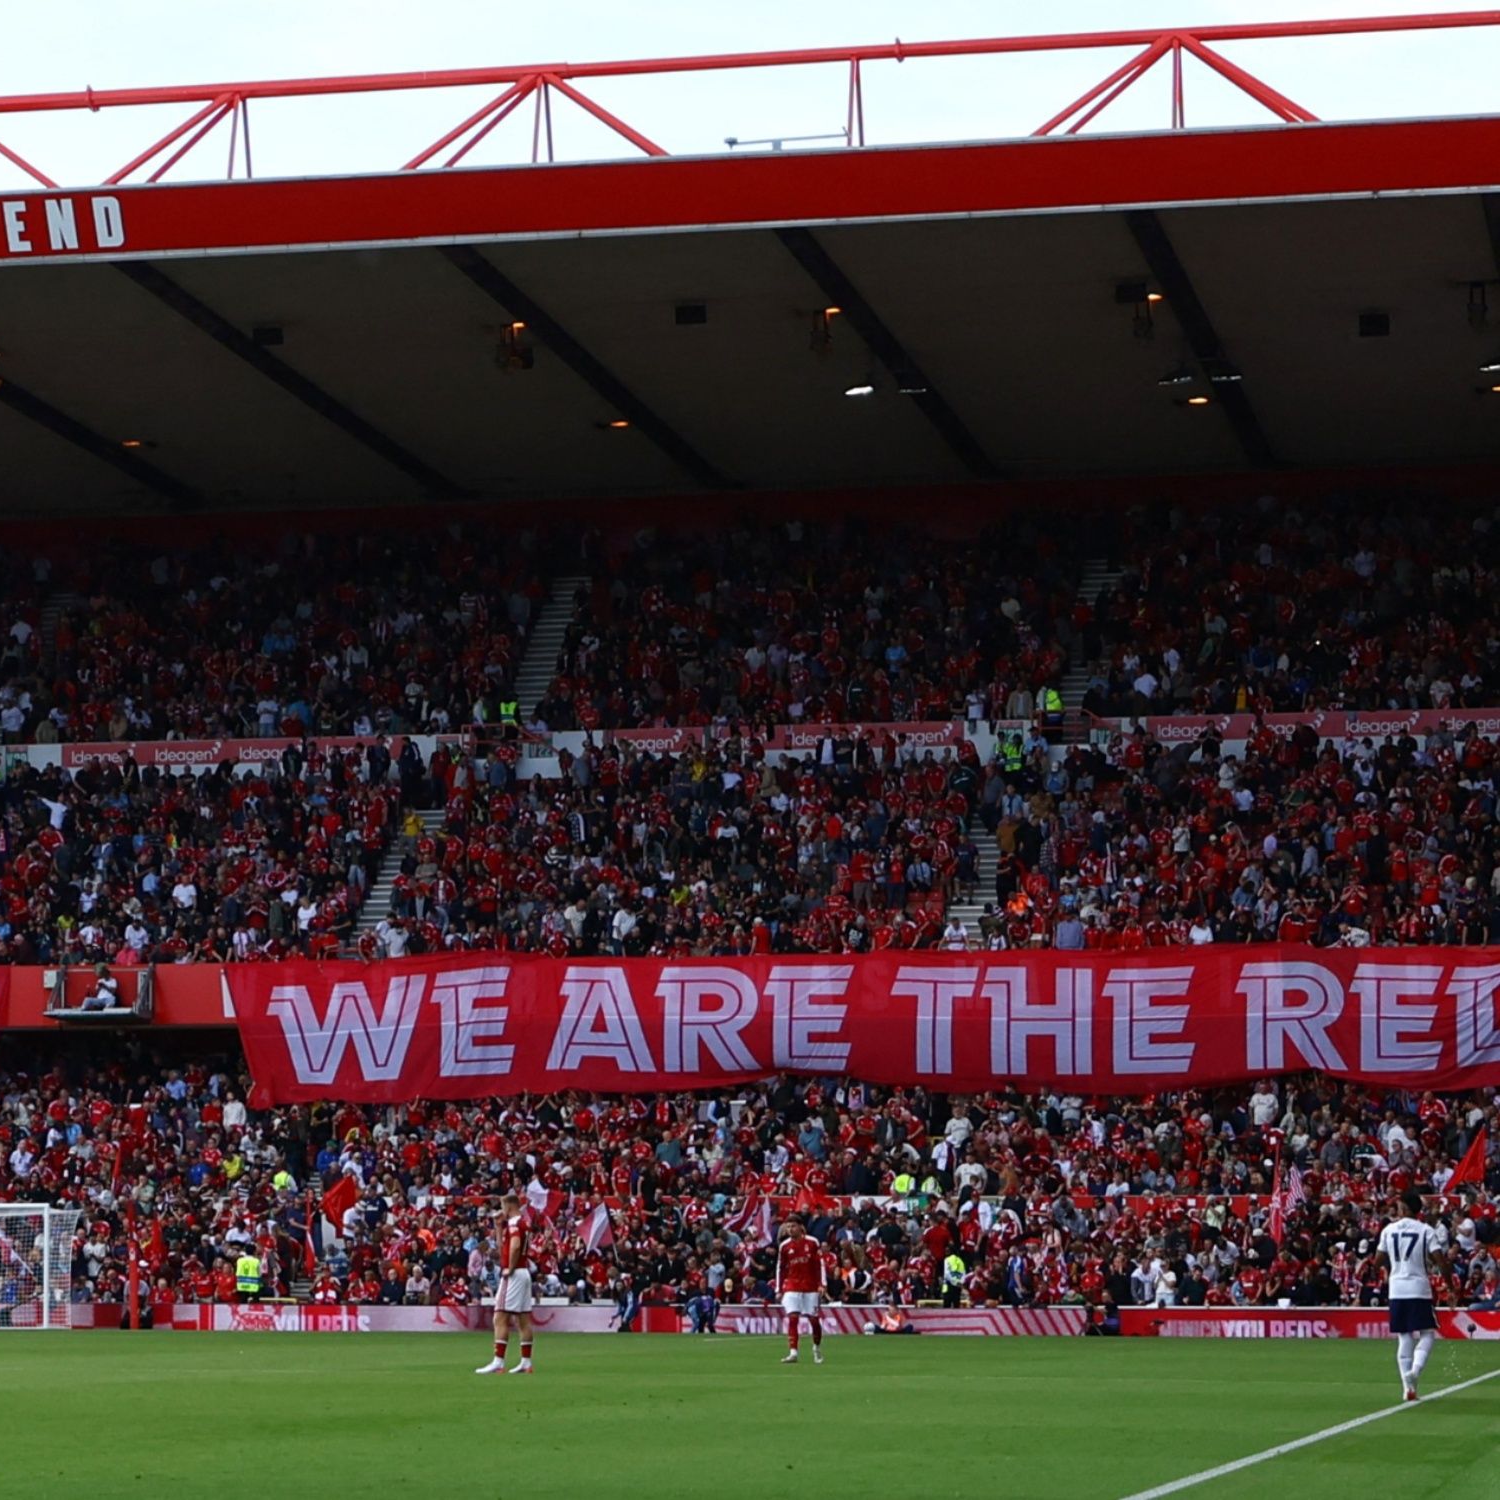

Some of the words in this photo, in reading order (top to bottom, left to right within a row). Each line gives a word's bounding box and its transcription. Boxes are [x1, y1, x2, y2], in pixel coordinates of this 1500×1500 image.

[2, 196, 125, 252] END
[1345, 719, 1410, 735] Ideagen
[155, 748, 213, 764] Ideagen
[265, 966, 515, 1085] WE
[545, 964, 855, 1073] ARE
[890, 965, 1195, 1076] THE
[1391, 1232, 1419, 1262] 17
